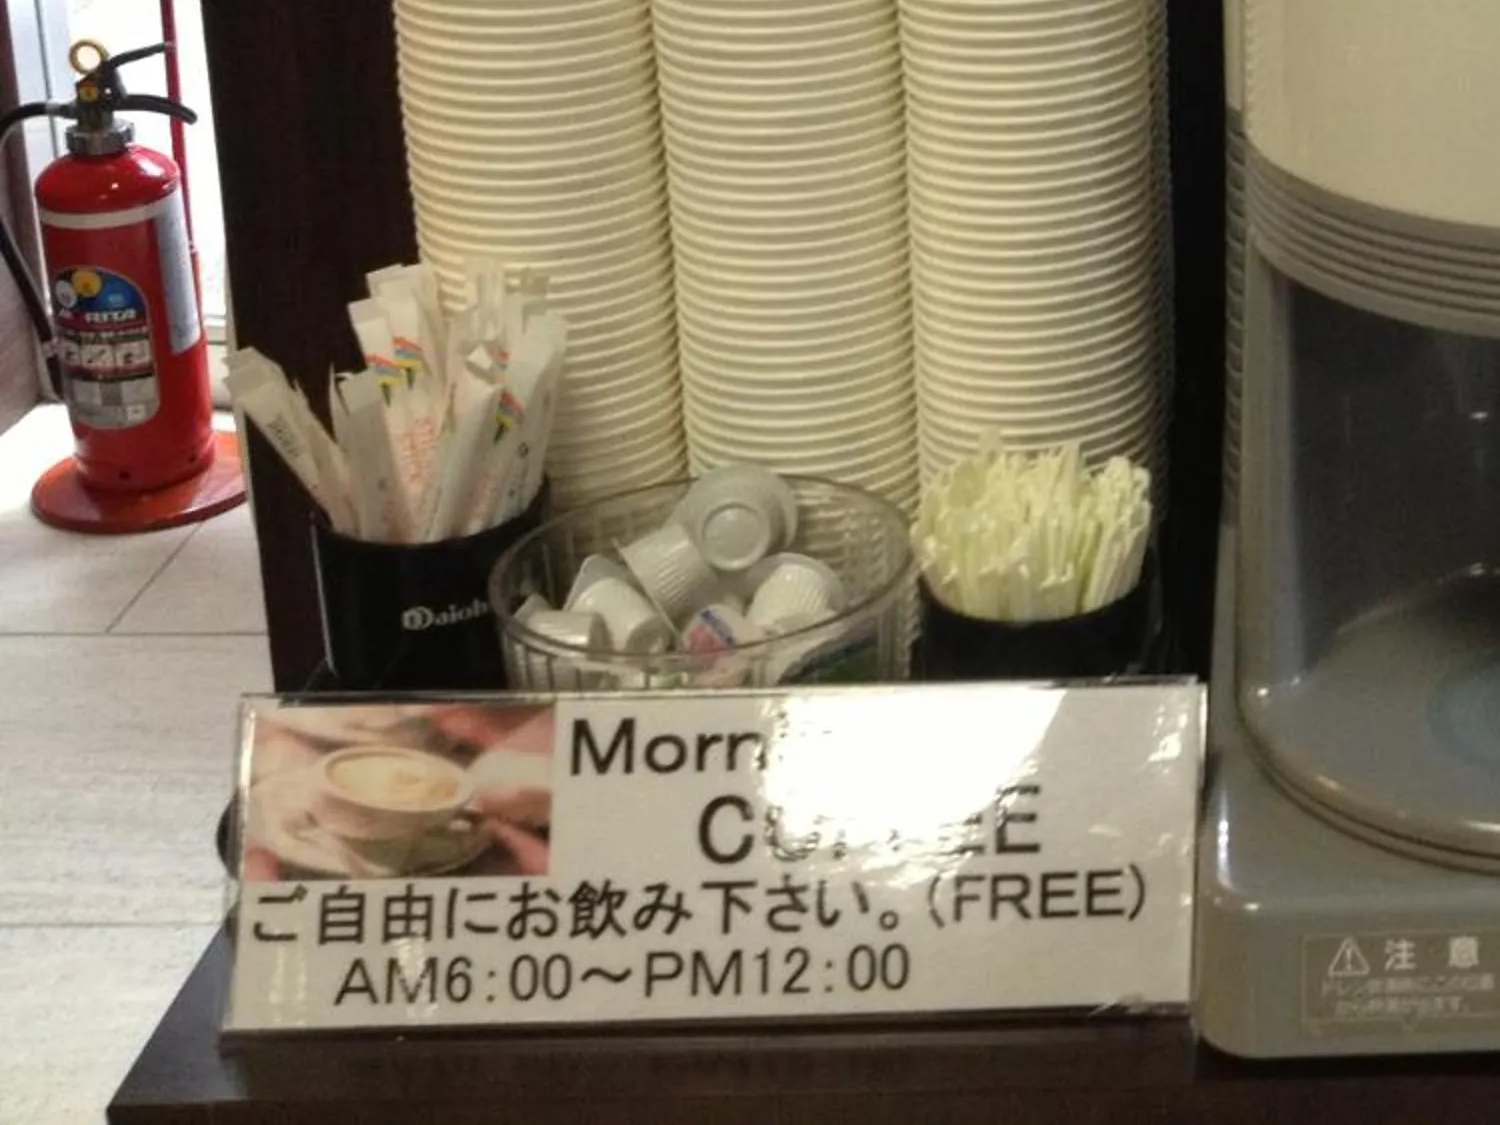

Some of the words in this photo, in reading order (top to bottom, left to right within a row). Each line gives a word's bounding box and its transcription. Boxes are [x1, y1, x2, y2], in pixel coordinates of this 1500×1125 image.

[570, 717, 785, 776] Morn
[697, 783, 1042, 864] COE
[925, 864, 1149, 928] (FREE)
